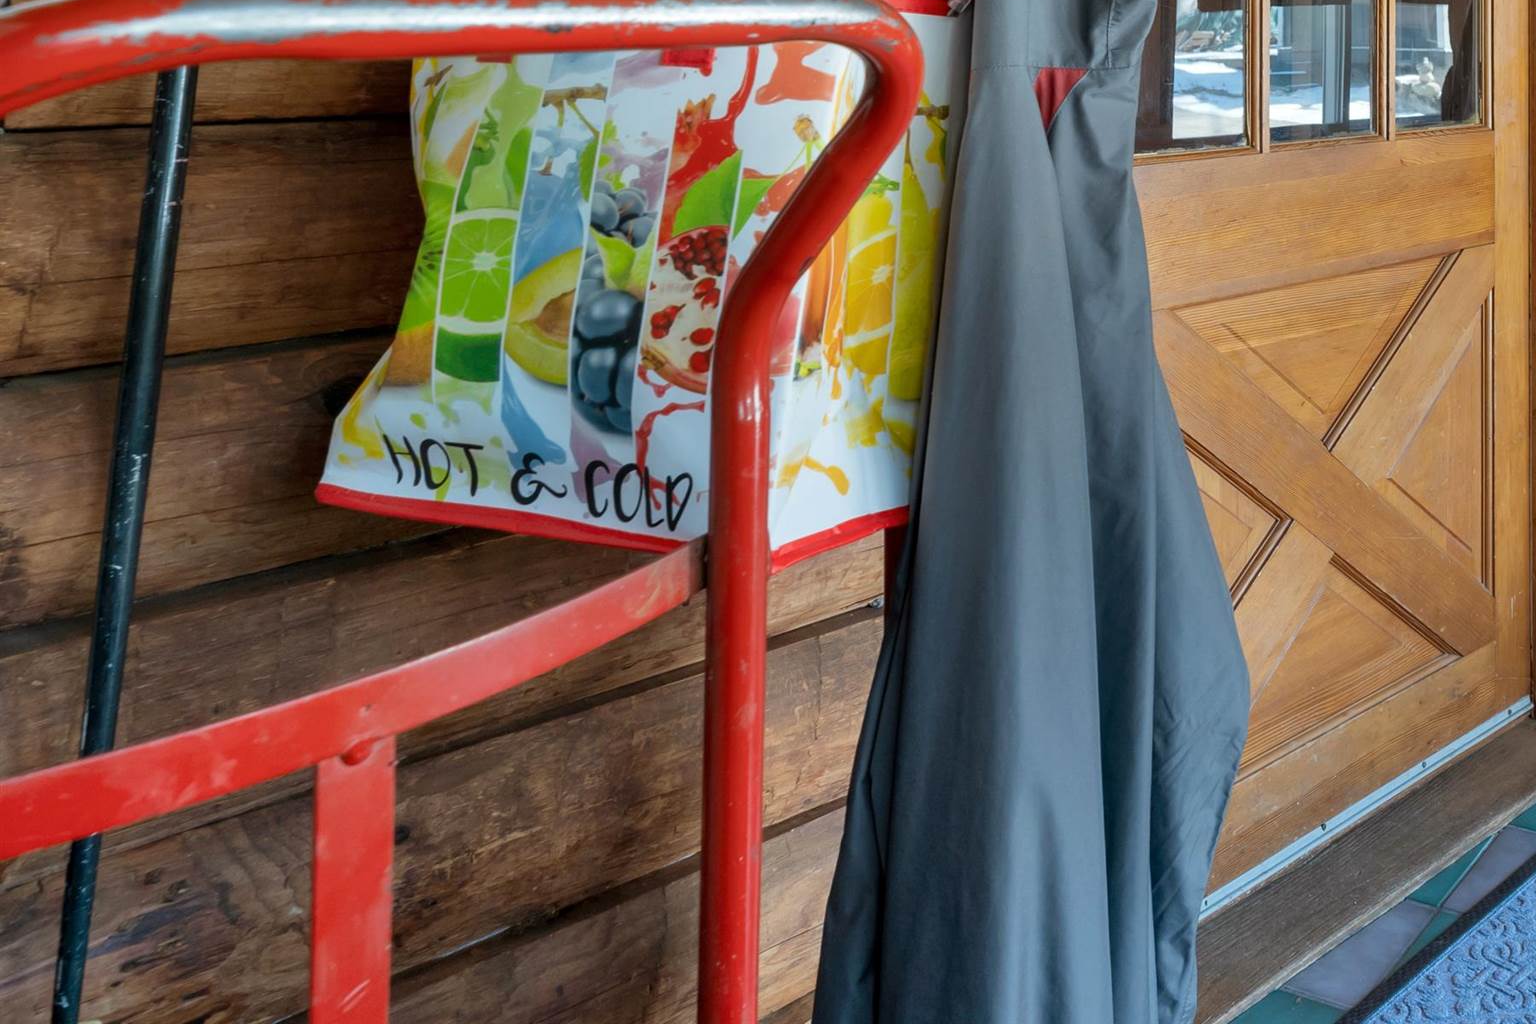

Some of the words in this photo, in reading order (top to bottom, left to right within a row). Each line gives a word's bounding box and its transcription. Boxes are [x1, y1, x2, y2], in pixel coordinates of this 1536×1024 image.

[382, 434, 484, 497] HOT
[510, 451, 567, 506] &
[583, 459, 693, 532] COLD
